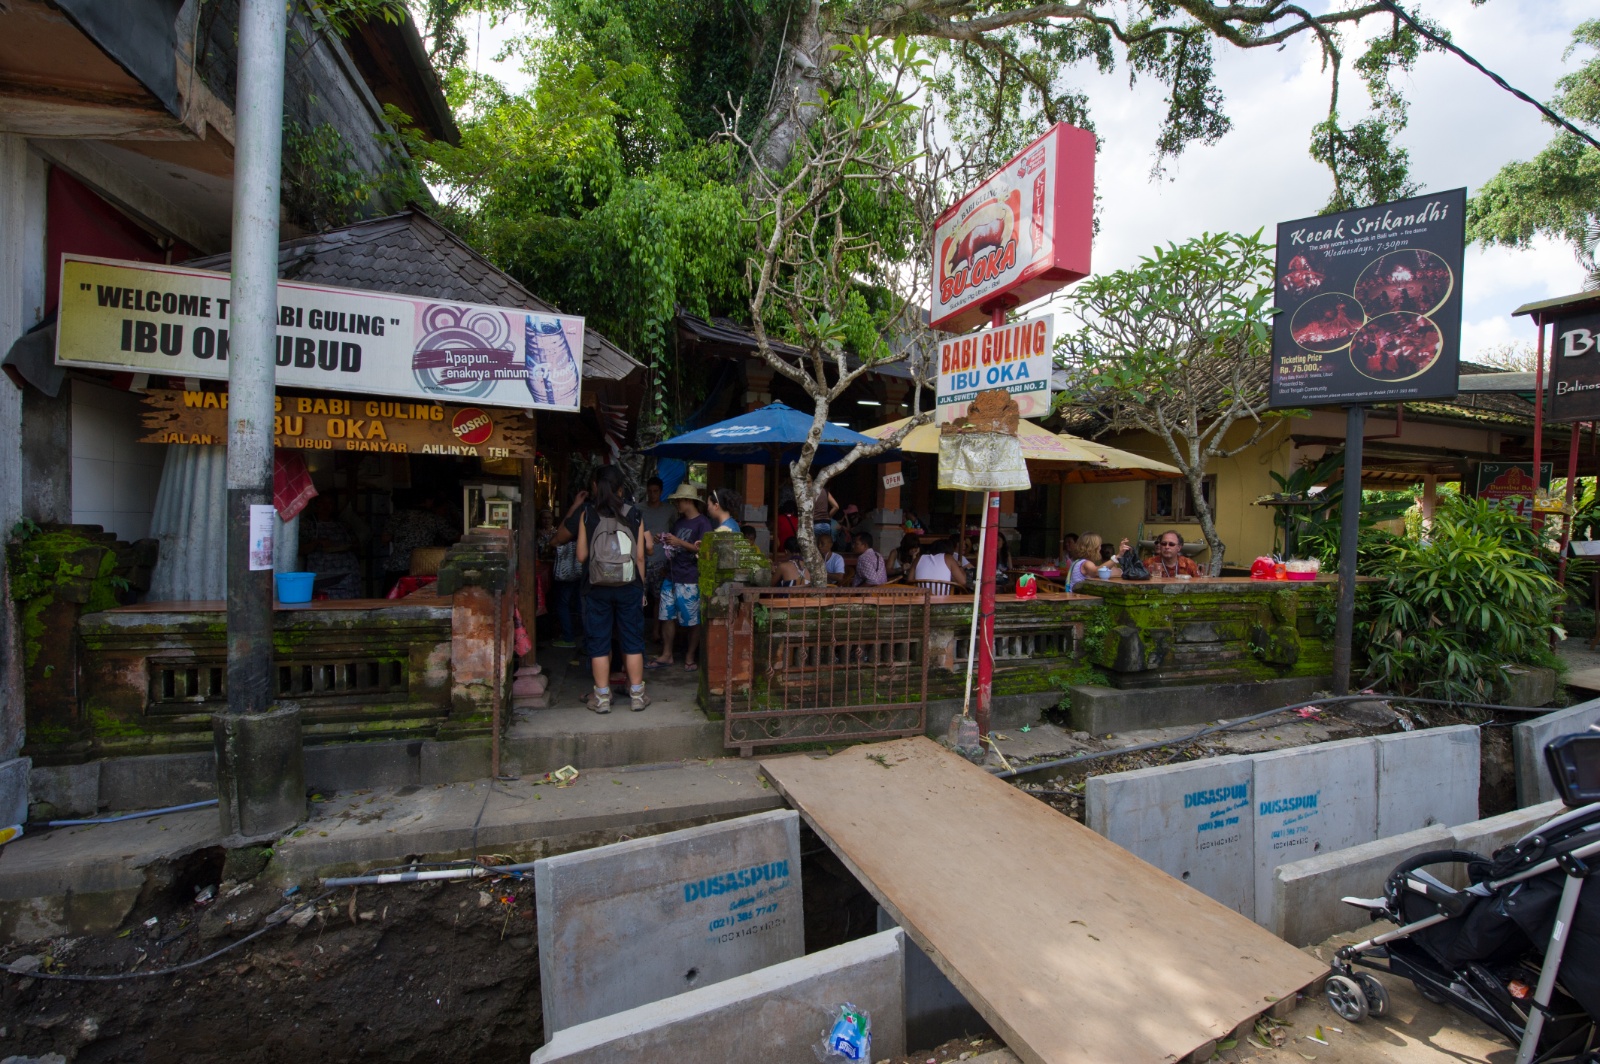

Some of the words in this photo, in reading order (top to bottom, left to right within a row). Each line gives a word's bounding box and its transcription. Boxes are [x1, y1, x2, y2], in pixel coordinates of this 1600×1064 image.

[1290, 218, 1345, 246] Kecak
[1351, 201, 1449, 235] Srikandhi
[1319, 243, 1330, 251] only
[1331, 238, 1353, 248] women's
[1413, 227, 1428, 235] dance
[1323, 243, 1374, 257] Wednesdays,
[1376, 240, 1408, 251] 7:30pm
[971, 240, 1016, 287] OKA
[308, 308, 385, 337] GULING
[120, 319, 183, 356] IBU
[942, 337, 978, 375] BABI
[982, 320, 1046, 367] GULING
[445, 350, 498, 367] Apapun...
[1280, 366, 1291, 375] Rp.
[1281, 355, 1306, 365] Ticketing
[1307, 353, 1323, 362] Price
[446, 368, 490, 381] enaknya
[494, 368, 529, 379] minum
[951, 370, 980, 391] IBU
[986, 361, 1030, 385] OKA
[1023, 382, 1038, 391] NO.
[1040, 381, 1045, 390] 2
[297, 397, 350, 416] BABI
[365, 401, 444, 421] GULING
[327, 418, 388, 440] OKA
[452, 413, 489, 438] SOSRO
[296, 438, 332, 450] UBUD
[346, 440, 407, 453] GIANYAR
[422, 443, 478, 457] AHLINYA
[488, 447, 509, 458] TEH
[885, 475, 901, 485] OPEN
[1184, 783, 1247, 809] DUSASPUN
[1260, 794, 1317, 816] DUSASPUN
[684, 859, 789, 903] DUSASPUN
[708, 915, 735, 932] (021)
[755, 902, 779, 917] 7747
